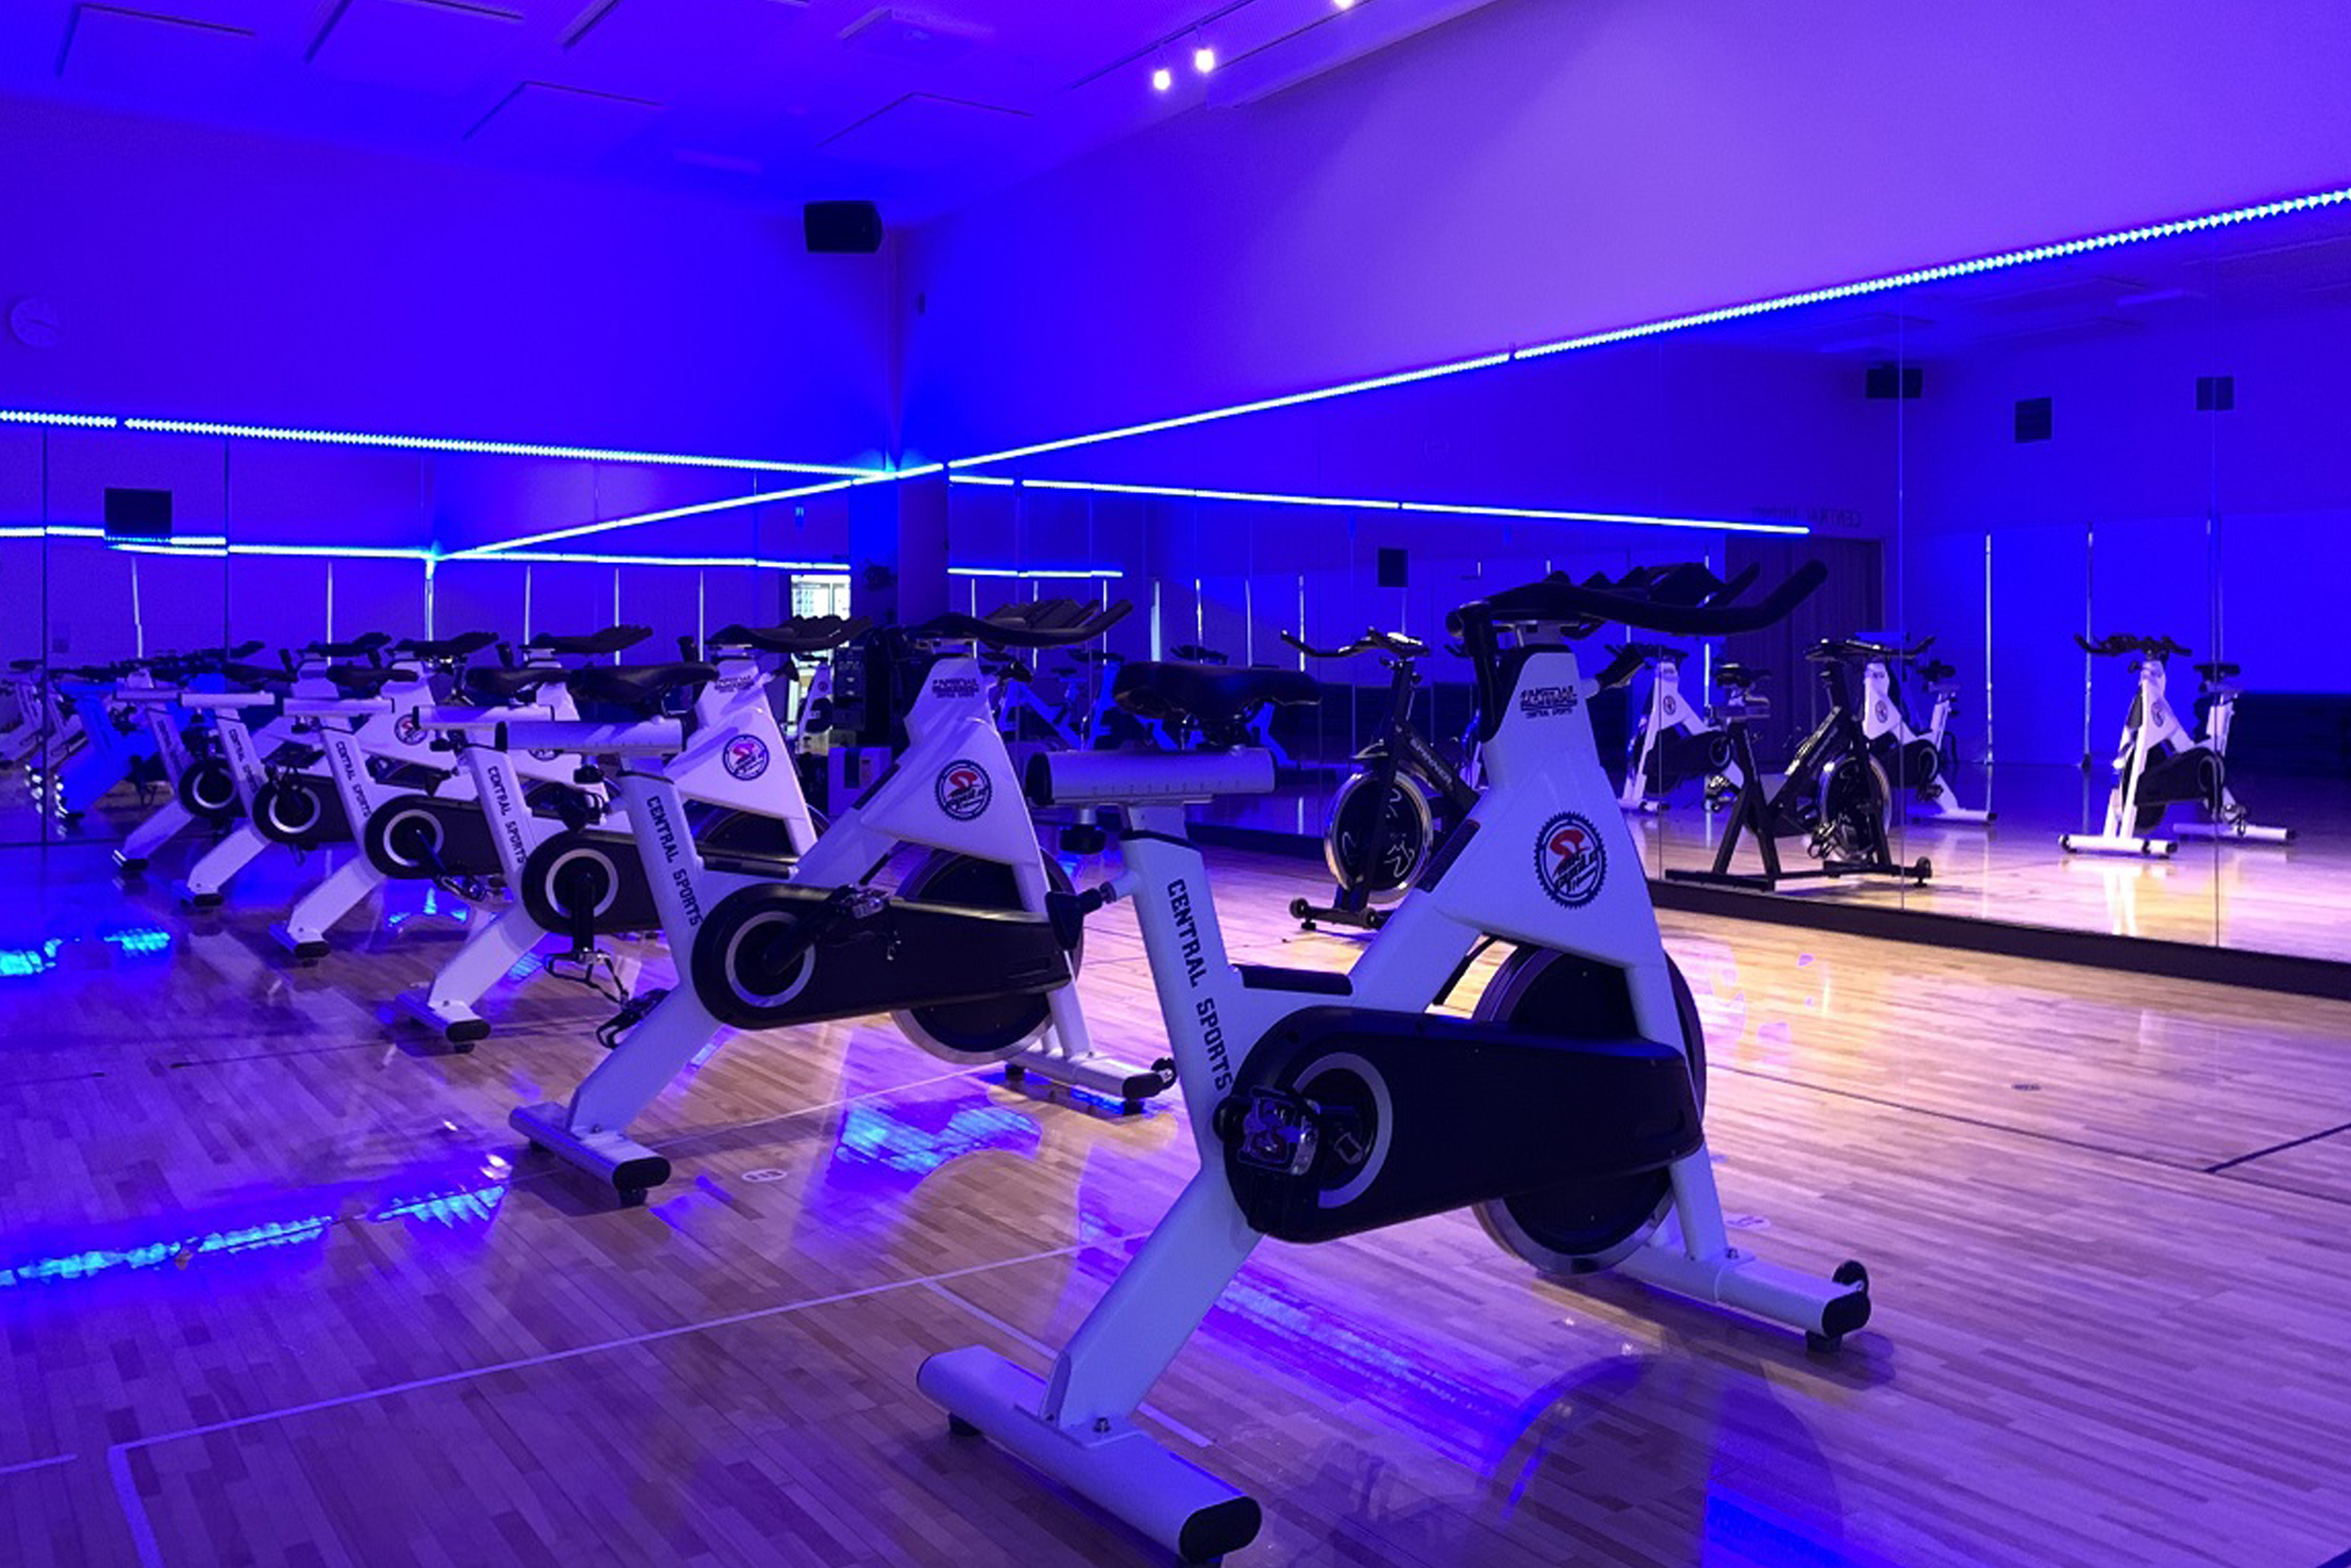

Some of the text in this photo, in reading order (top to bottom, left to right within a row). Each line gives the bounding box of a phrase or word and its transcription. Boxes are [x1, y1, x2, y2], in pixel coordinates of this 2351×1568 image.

[336, 740, 373, 817] CENTRAL SPORTS
[487, 766, 527, 864] CENTRAL SPORTS
[647, 795, 703, 926] CENTRAL SPORTS
[1167, 879, 1232, 1091] CENTRAL SPORTS
